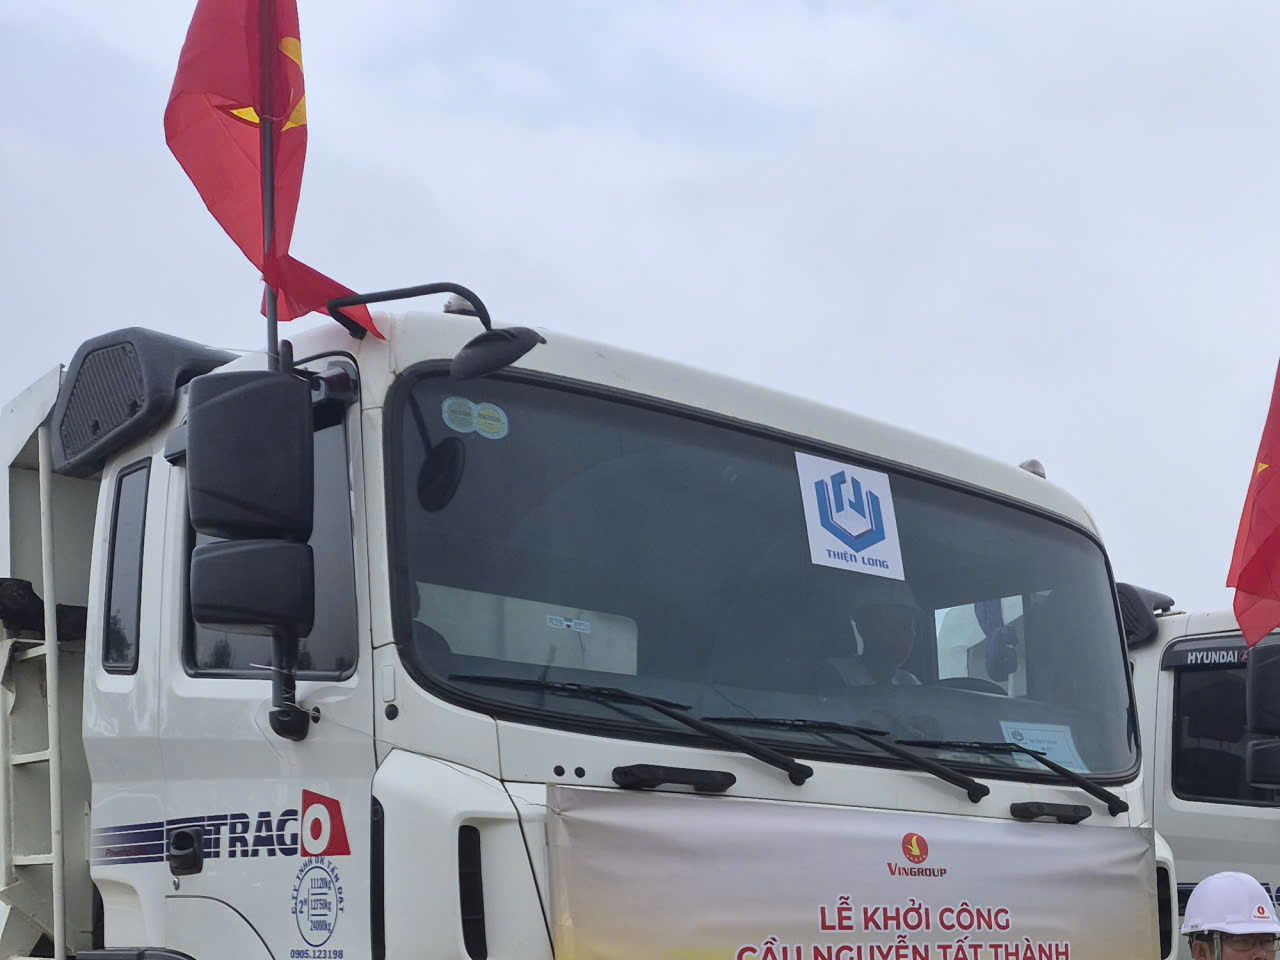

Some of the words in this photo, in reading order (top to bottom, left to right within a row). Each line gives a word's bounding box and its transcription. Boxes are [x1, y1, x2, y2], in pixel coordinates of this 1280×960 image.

[862, 556, 889, 569] LONG
[1187, 650, 1239, 664] HYUNDAI
[205, 803, 331, 858] TRAGO
[887, 862, 947, 878] VINGROUP
[819, 895, 854, 932] LỄ
[862, 898, 931, 932] KHỞI
[938, 901, 1011, 932] CÔNG
[290, 949, 344, 960] 0905.123198
